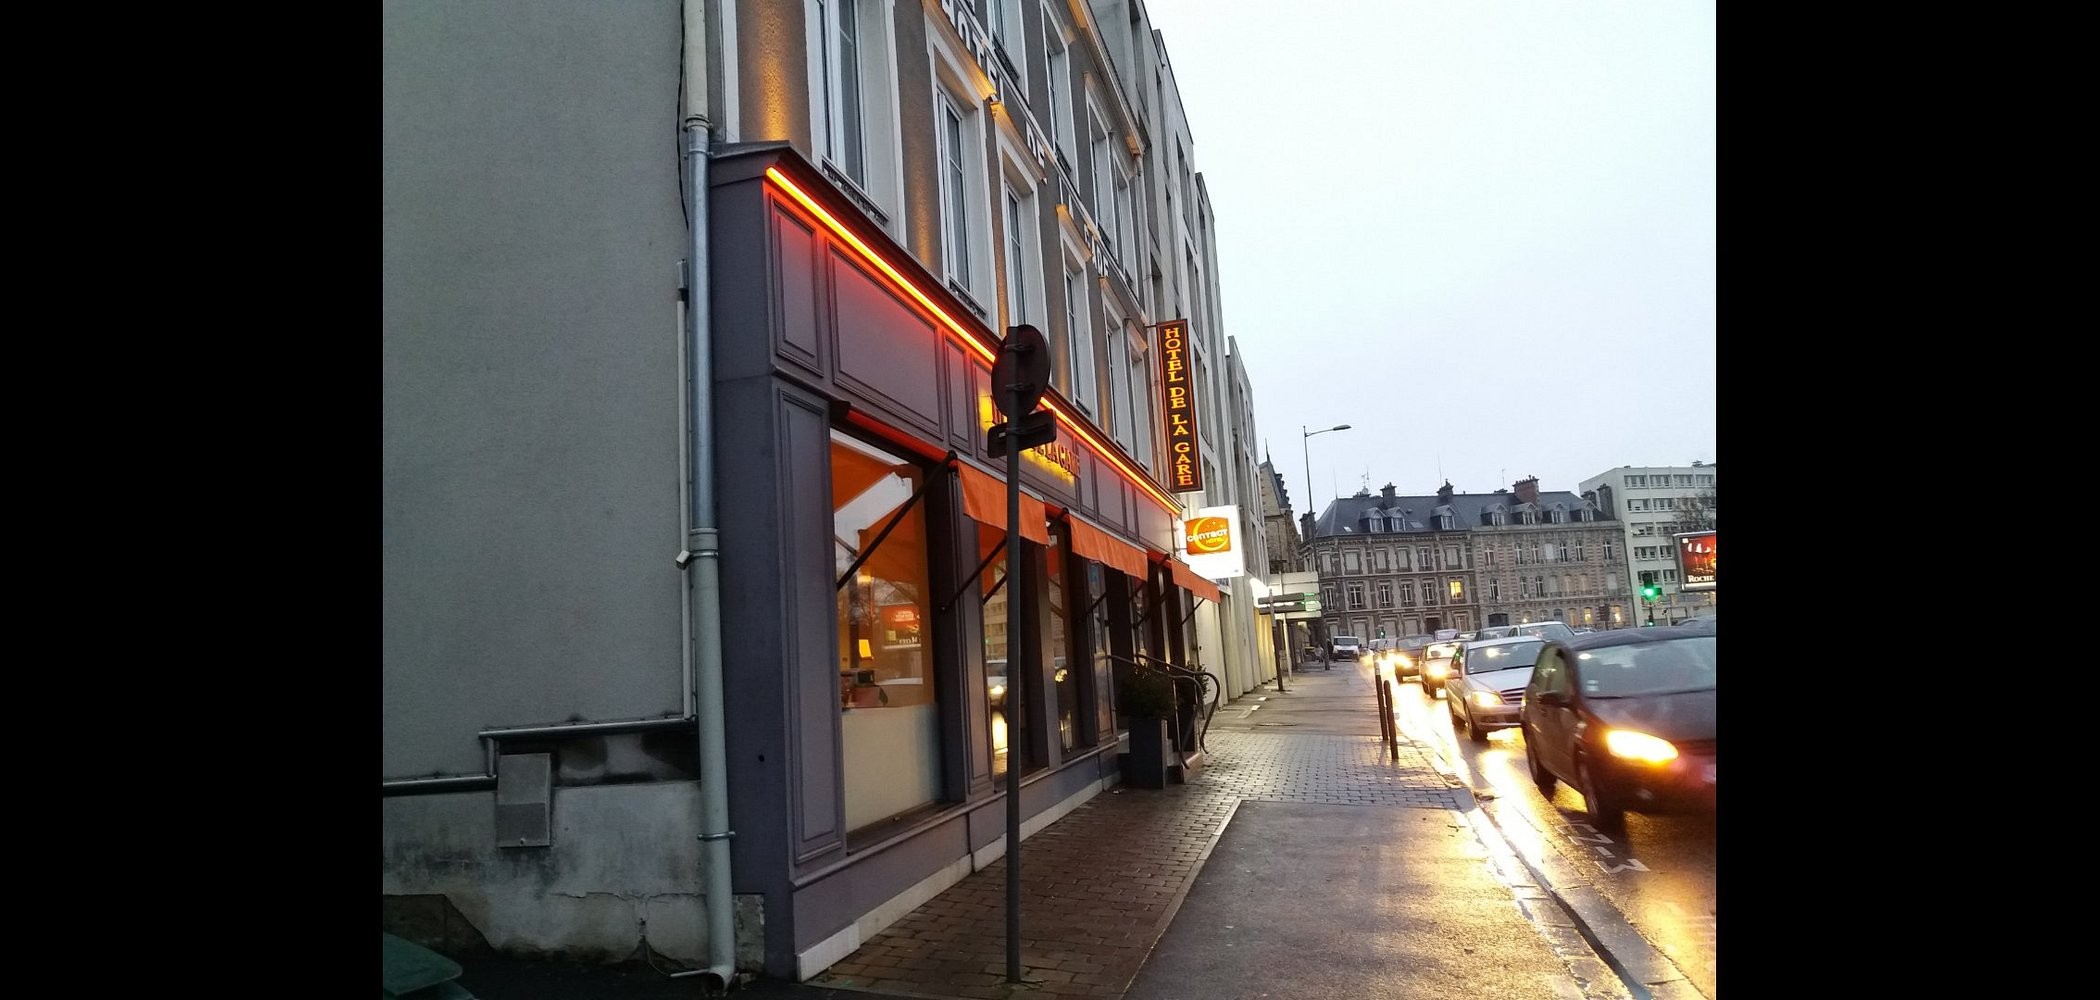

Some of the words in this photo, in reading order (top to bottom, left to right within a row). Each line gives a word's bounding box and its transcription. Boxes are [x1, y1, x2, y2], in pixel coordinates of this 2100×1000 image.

[1164, 327, 1184, 383] HOTEL
[1170, 387, 1187, 409] DE
[1172, 413, 1189, 436] LA
[1174, 442, 1194, 486] GARE
